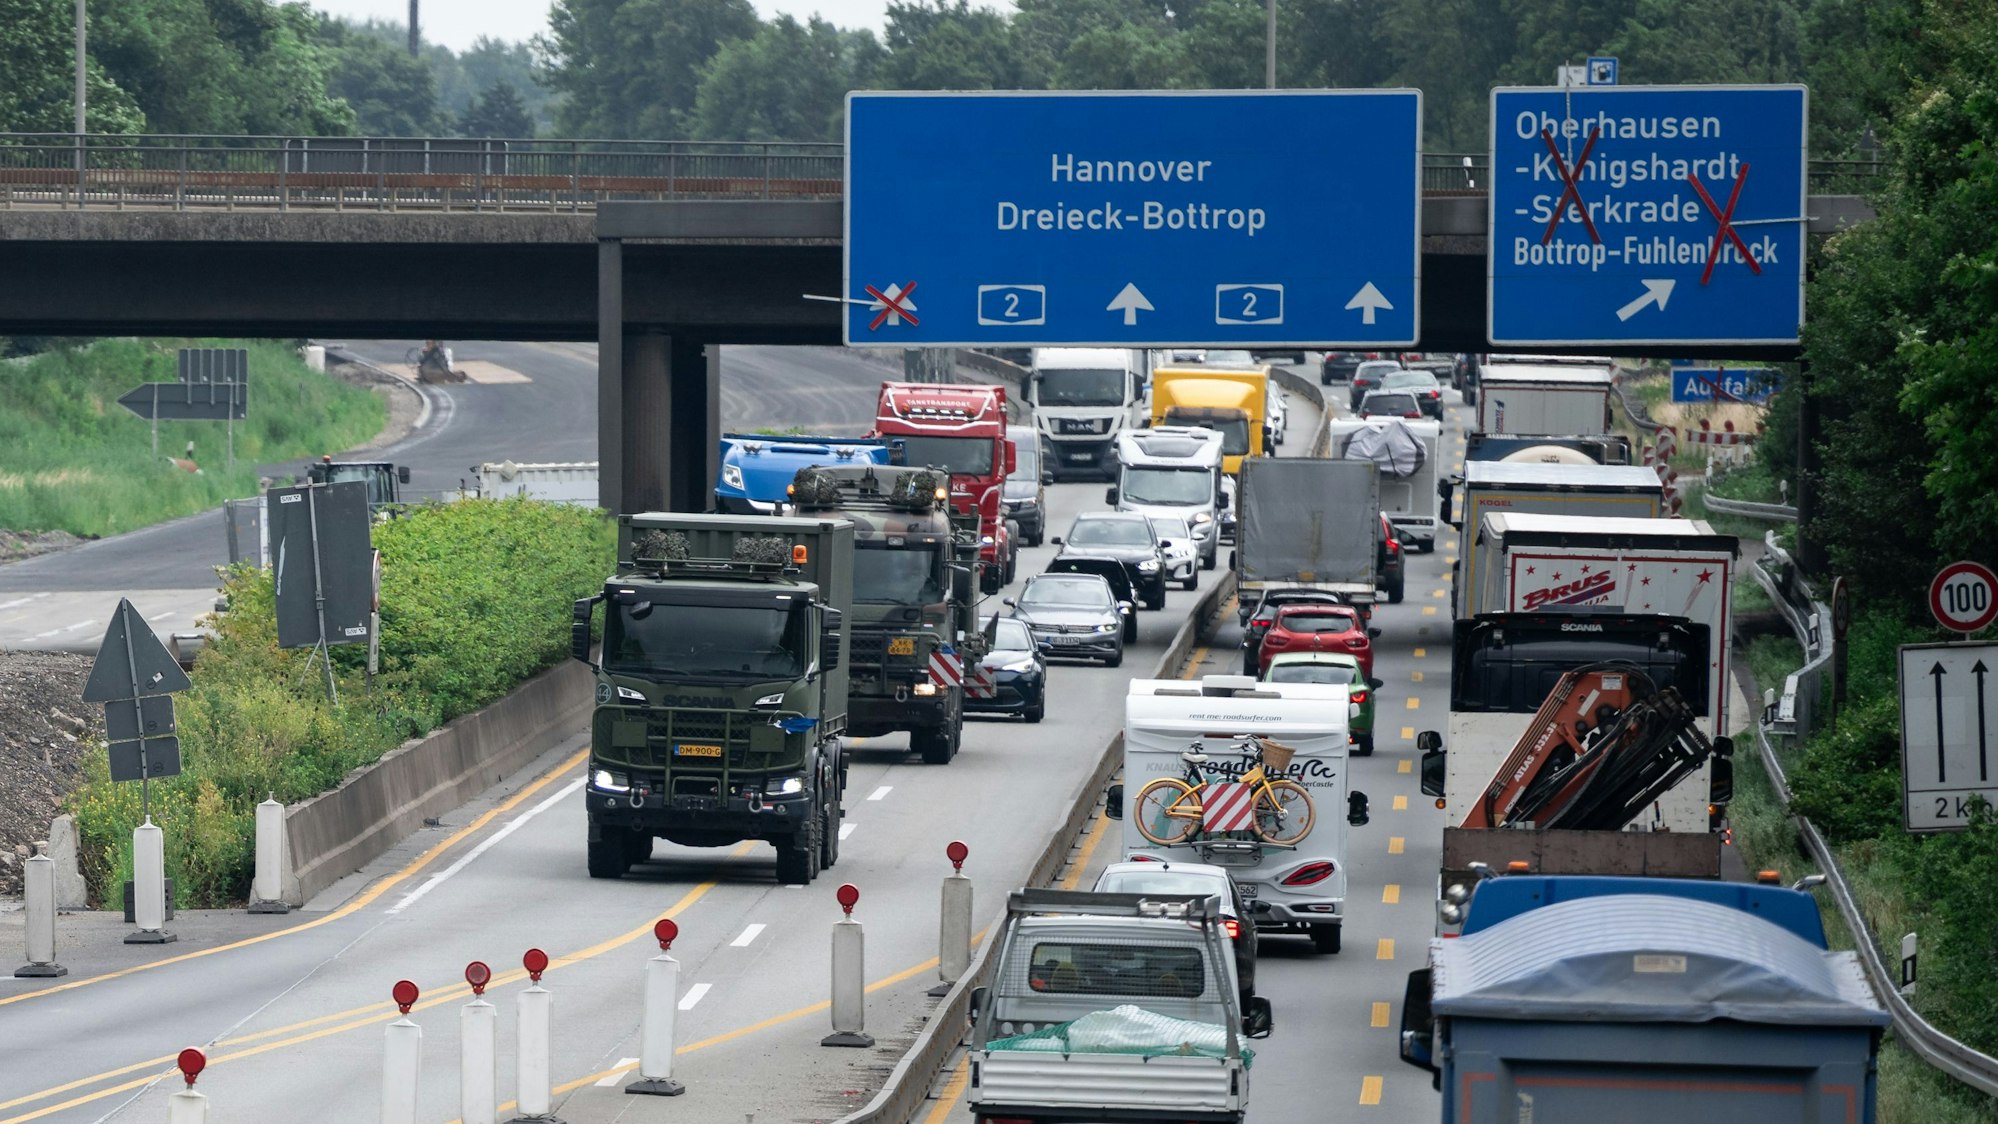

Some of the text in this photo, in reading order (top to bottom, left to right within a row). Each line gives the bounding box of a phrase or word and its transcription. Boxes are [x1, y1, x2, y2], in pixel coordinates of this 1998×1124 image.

[1515, 111, 1721, 139] Oberhausen
[1051, 153, 1211, 182] Hannover
[1515, 152, 1740, 188] -Königshardt
[997, 201, 1267, 236] Dreieck-Bottrop
[1004, 293, 1020, 317] 2
[1242, 292, 1258, 316] 2
[1522, 570, 1611, 610] BRUS
[1944, 582, 1987, 613] 100
[1561, 623, 1603, 632] SCANIA
[663, 694, 736, 708] SCANIA
[1223, 714, 1282, 722] roadsurfer.com
[1146, 762, 1186, 772] KNAUS
[1513, 755, 1535, 782] ATLAS
[1935, 797, 1949, 818] 2
